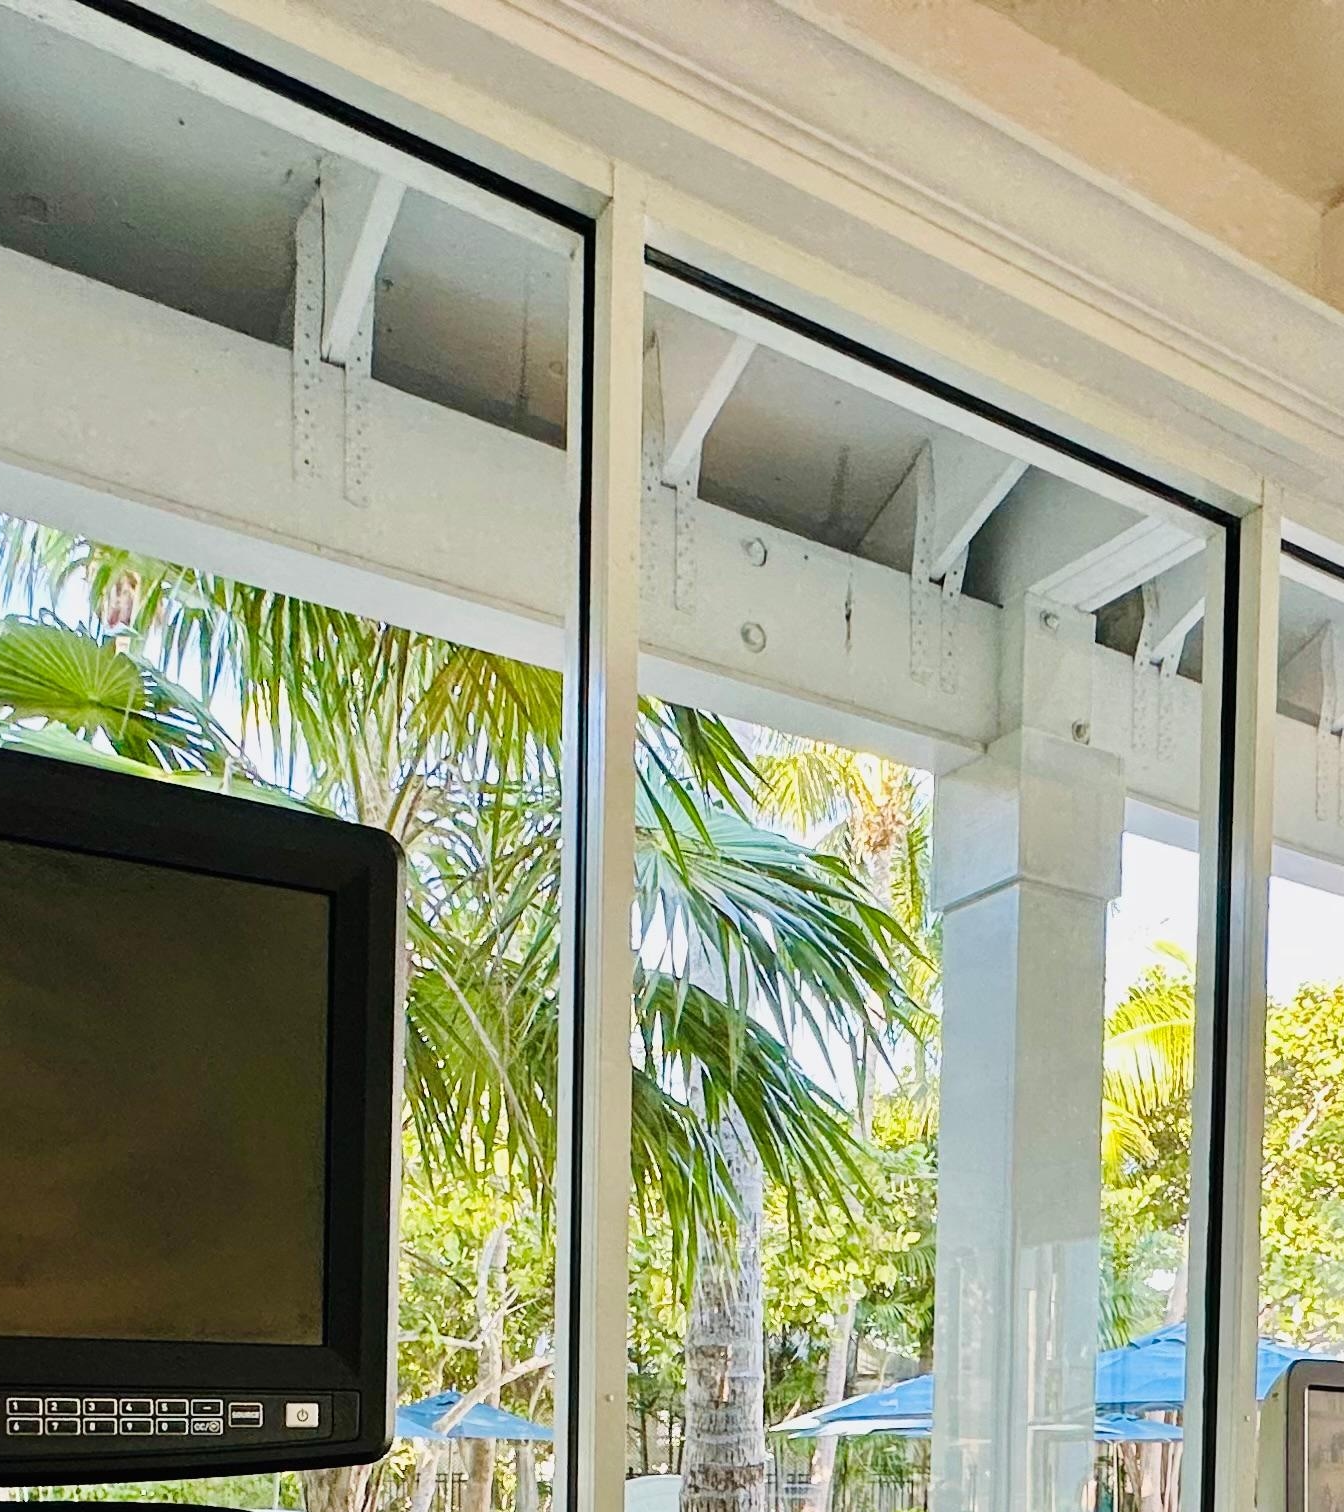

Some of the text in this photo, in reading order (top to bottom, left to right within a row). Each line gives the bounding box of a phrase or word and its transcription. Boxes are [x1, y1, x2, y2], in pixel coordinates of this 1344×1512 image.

[50, 1402, 58, 1411] 2
[88, 1402, 96, 1411] 3
[125, 1402, 133, 1412] 4
[51, 1422, 59, 1432] 7
[126, 1422, 134, 1432] 9
